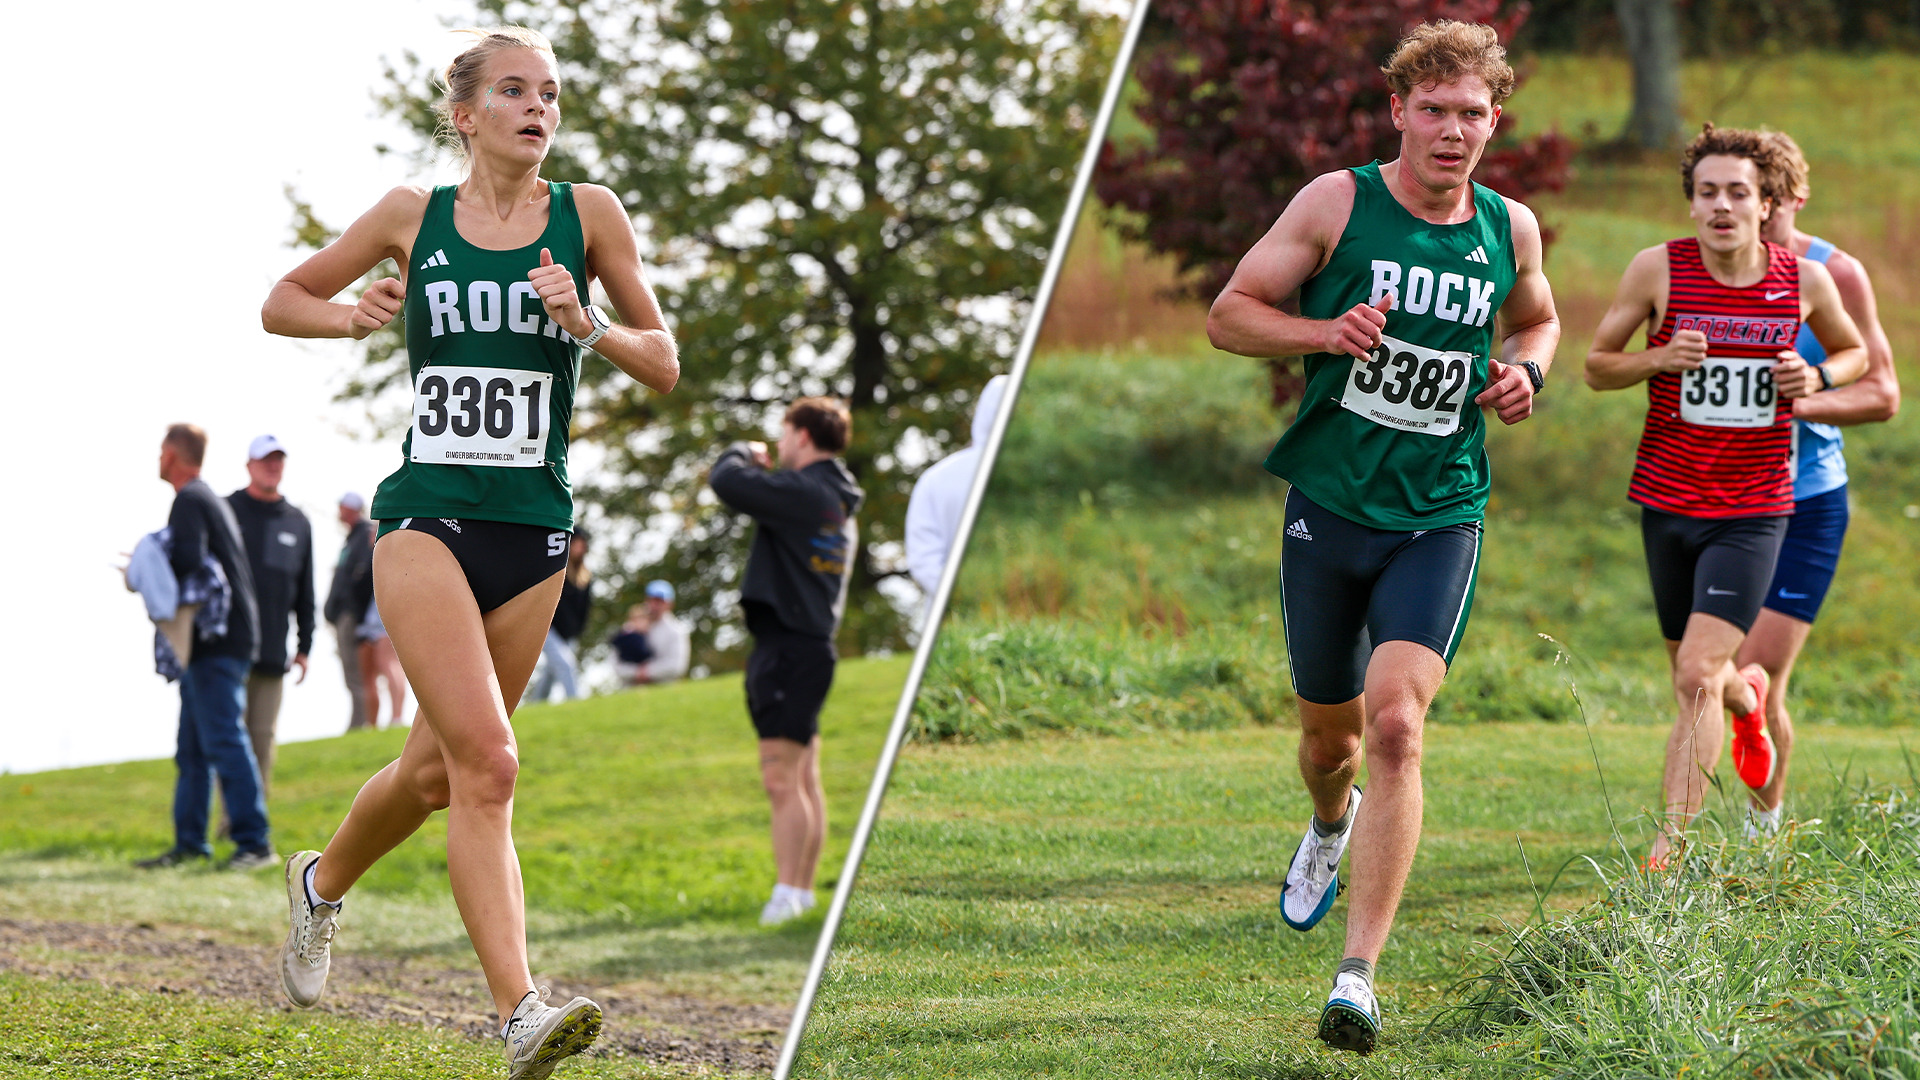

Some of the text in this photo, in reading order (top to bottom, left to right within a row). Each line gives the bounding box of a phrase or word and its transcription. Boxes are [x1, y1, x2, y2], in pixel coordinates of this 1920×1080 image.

[1368, 259, 1496, 328] ROCK
[1674, 316, 1796, 344] ROBERTS
[1354, 342, 1466, 413] 3382
[1686, 365, 1774, 407] 3318
[418, 375, 542, 440] 3361
[445, 450, 515, 462] GINGERBREADTIMING.COM
[547, 531, 567, 557] S
[1286, 528, 1313, 542] adidas
